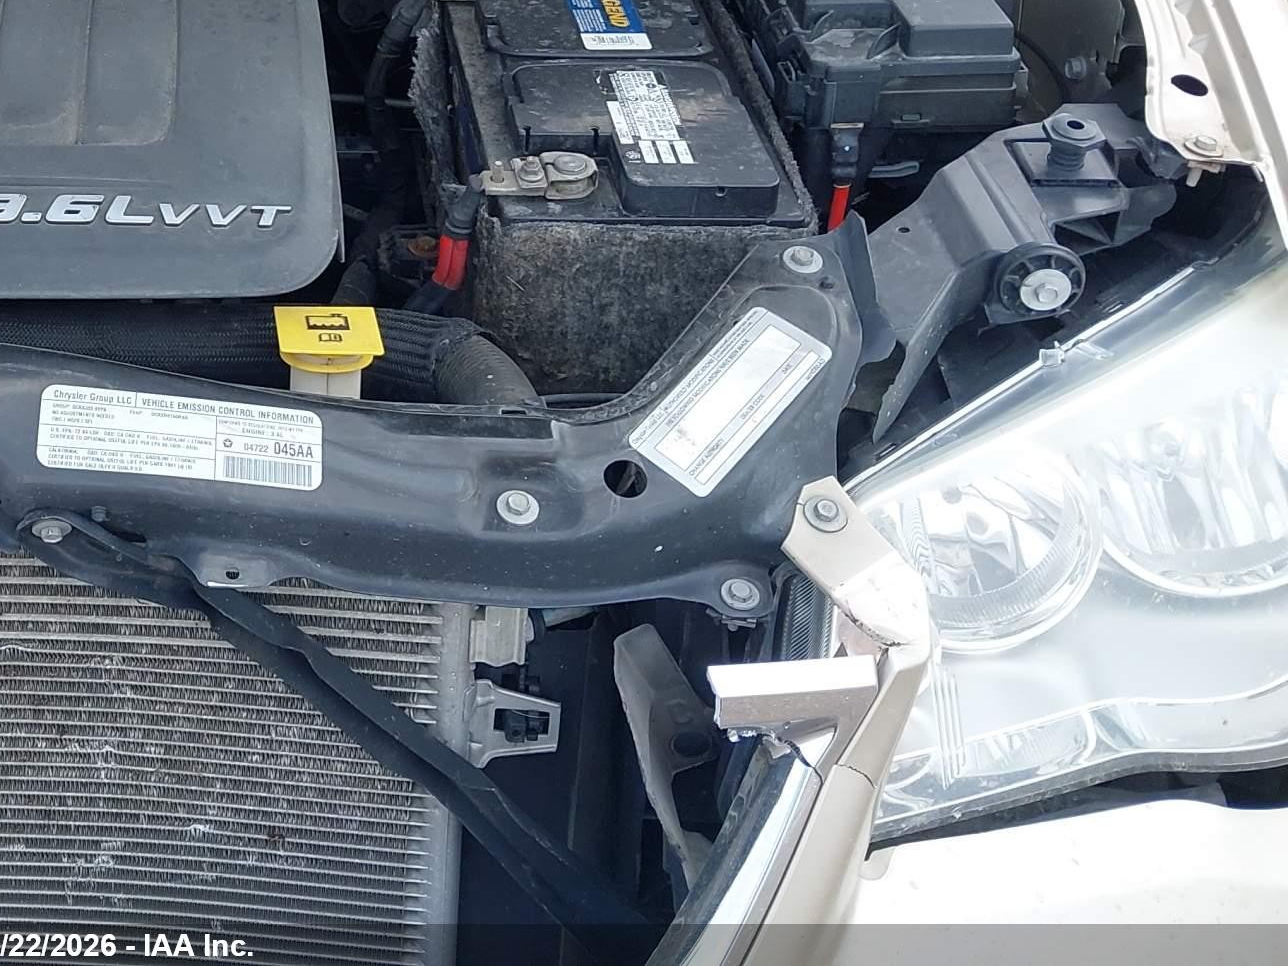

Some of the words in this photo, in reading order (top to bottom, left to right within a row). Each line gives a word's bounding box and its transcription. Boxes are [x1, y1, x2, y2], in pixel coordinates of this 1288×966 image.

[159, 202, 293, 227] VVT
[53, 389, 88, 401] Chrysler
[90, 392, 114, 404] Group
[117, 396, 132, 405] LLC
[142, 397, 174, 409] VEHICLE
[177, 400, 216, 413] EMISSION
[218, 406, 256, 418] CONTROL
[258, 410, 314, 425] INFORMATION
[243, 442, 269, 453] 04722
[273, 441, 314, 459] 045AA
